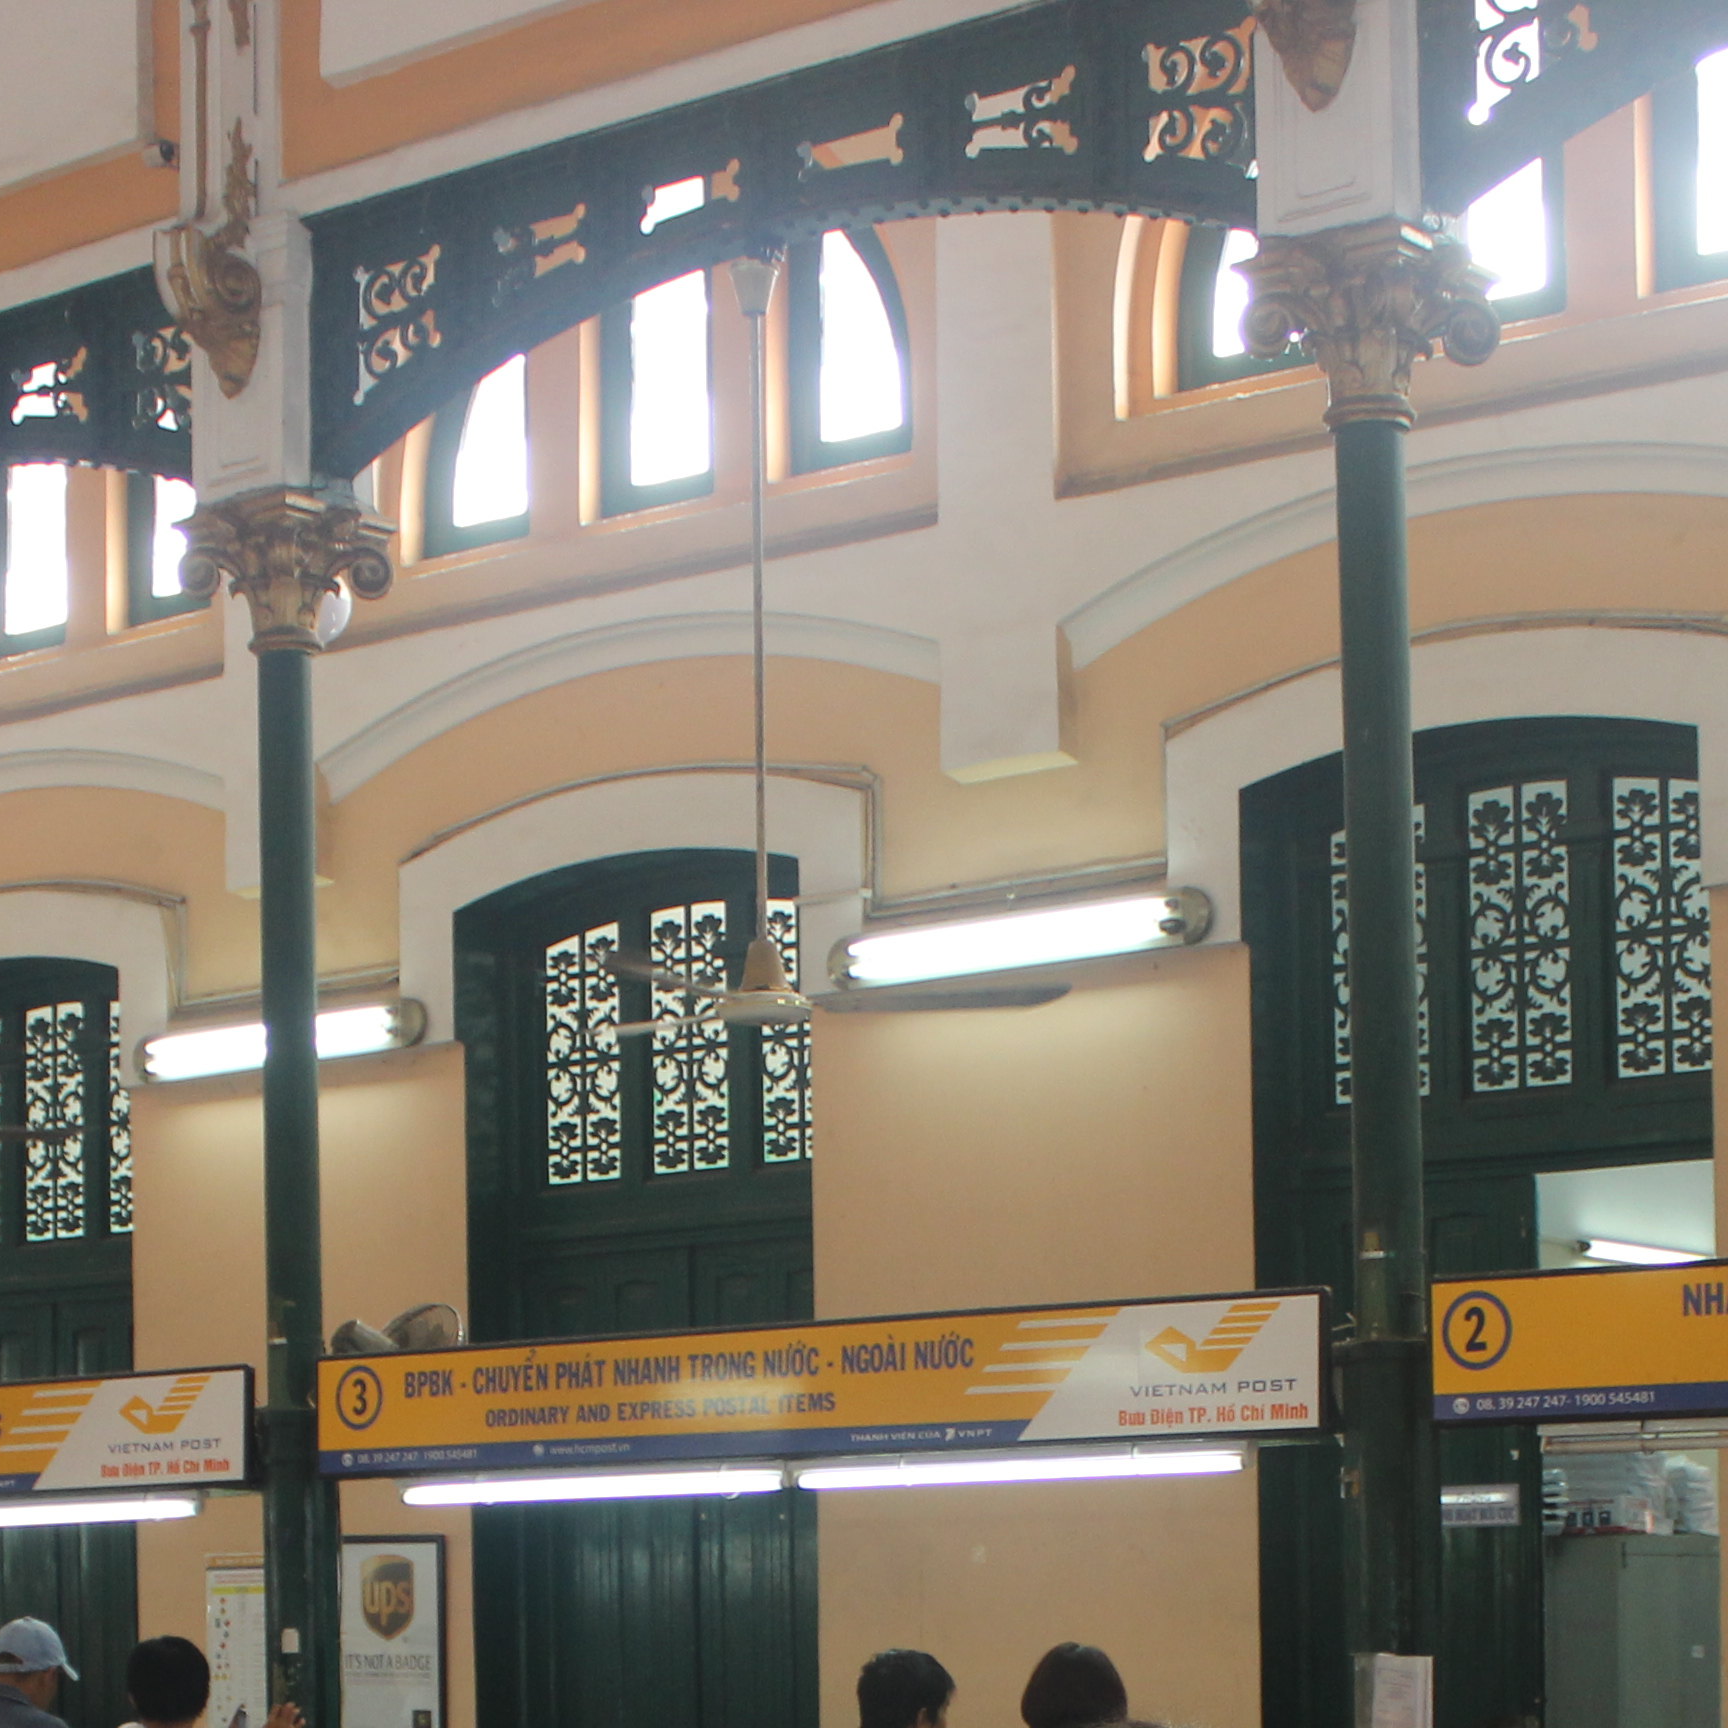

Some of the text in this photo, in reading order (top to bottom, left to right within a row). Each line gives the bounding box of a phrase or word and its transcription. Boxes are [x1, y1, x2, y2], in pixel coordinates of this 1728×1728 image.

[1464, 1306, 1487, 1352] 2
[404, 1331, 974, 1398] BPBK CHUYỂN PHÁT NHANH TRONG NƯỚC NGOÀI NƯỚC
[352, 1378, 367, 1416] 3
[1130, 1379, 1297, 1397] VIETNAM POST
[1499, 1398, 1514, 1409] 39
[1516, 1396, 1540, 1409] 247
[1575, 1394, 1605, 1406] 1900
[1609, 1391, 1655, 1404] 545481
[485, 1392, 836, 1427] ORDINARY AND EXPRESS POSTAL ITEMS
[1270, 1403, 1308, 1420] Minh
[107, 1438, 221, 1454] VIETNAM POST
[365, 1580, 410, 1627] ups
